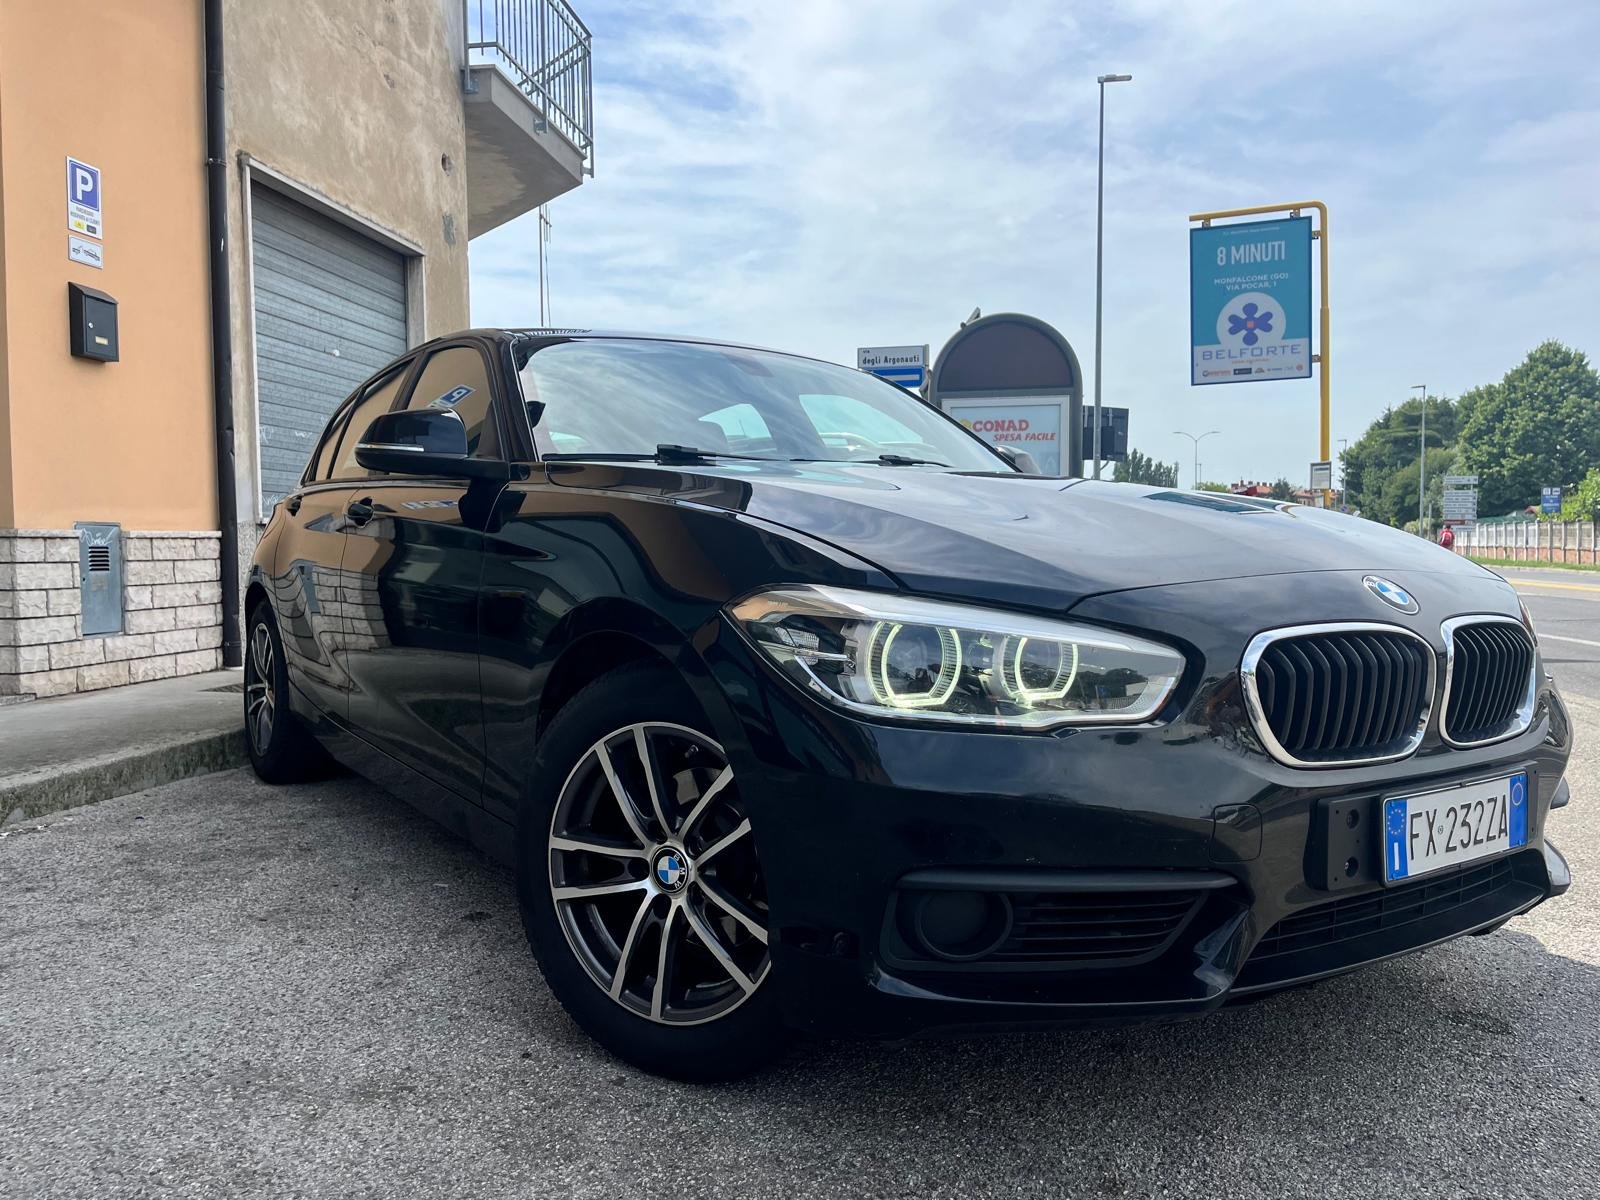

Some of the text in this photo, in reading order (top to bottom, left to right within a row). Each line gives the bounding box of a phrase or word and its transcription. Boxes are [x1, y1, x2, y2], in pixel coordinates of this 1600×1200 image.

[76, 168, 93, 201] P
[1217, 241, 1285, 266] 8 MINUTI
[1214, 272, 1289, 285] MONFALCONE (GO)
[1202, 344, 1301, 361] BELFORTE
[862, 354, 920, 366] degli Argonauti
[972, 419, 1029, 432] CONAD
[993, 432, 1056, 442] SPESA FACILE
